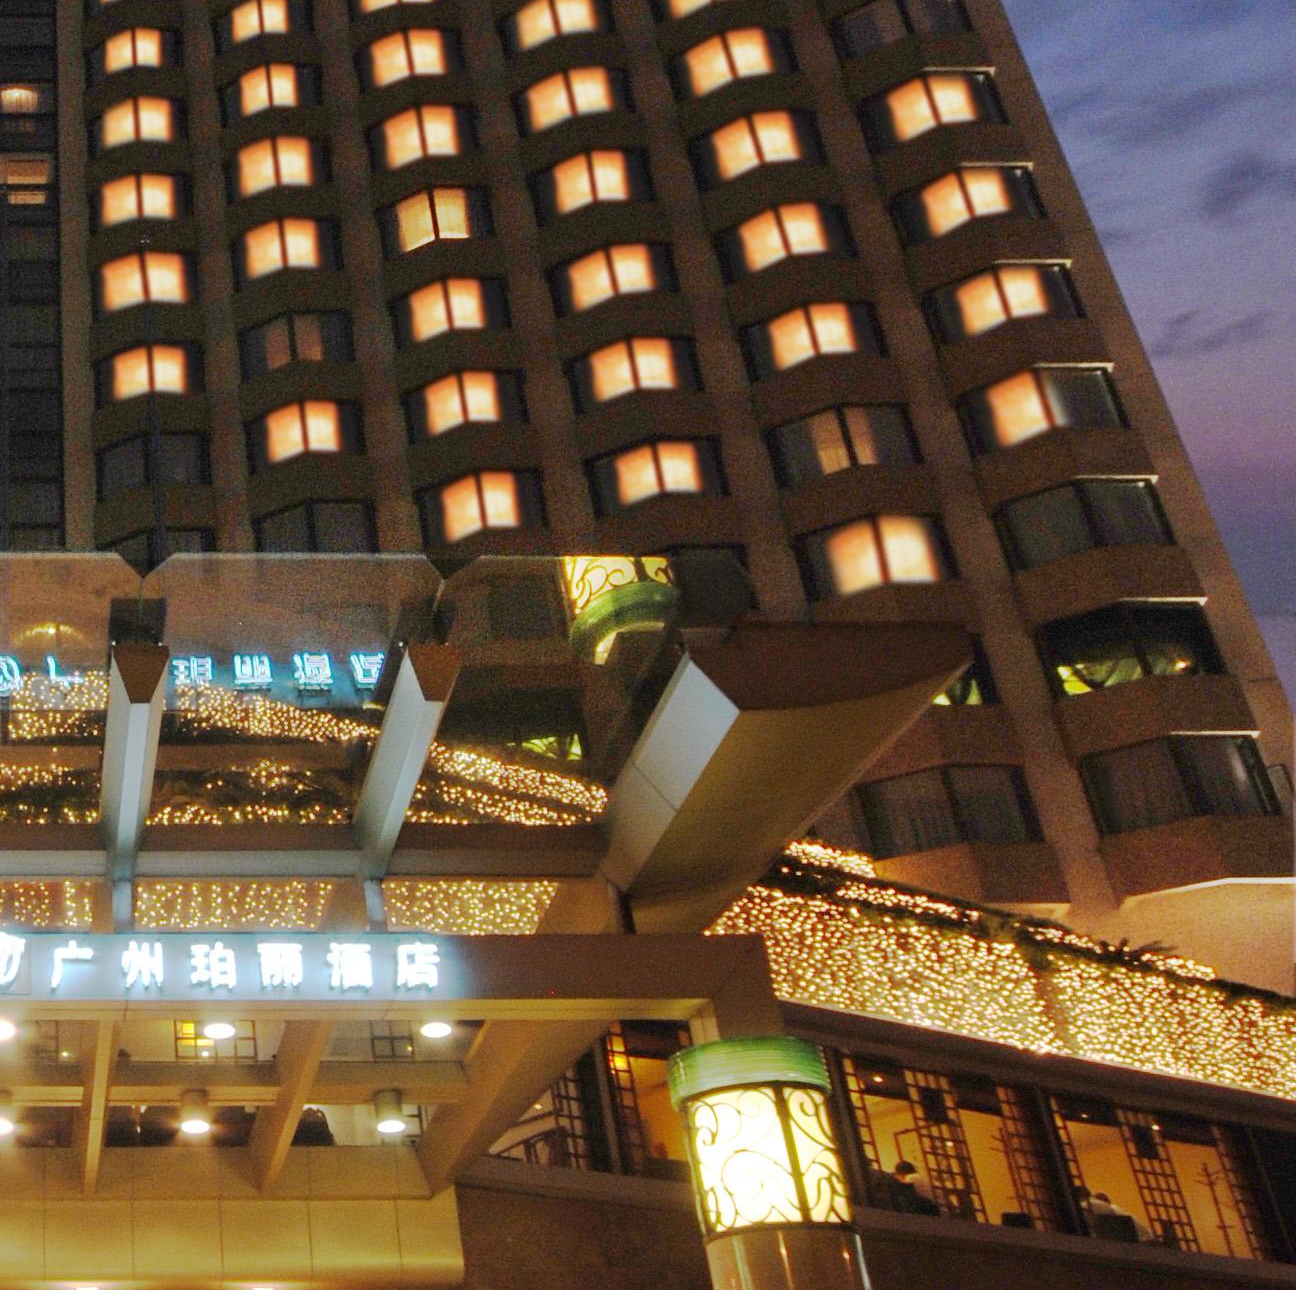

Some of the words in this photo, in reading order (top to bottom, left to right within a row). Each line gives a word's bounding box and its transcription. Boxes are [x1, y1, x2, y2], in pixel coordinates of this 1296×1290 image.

[50, 939, 441, 989] 广州珀丽酒店
